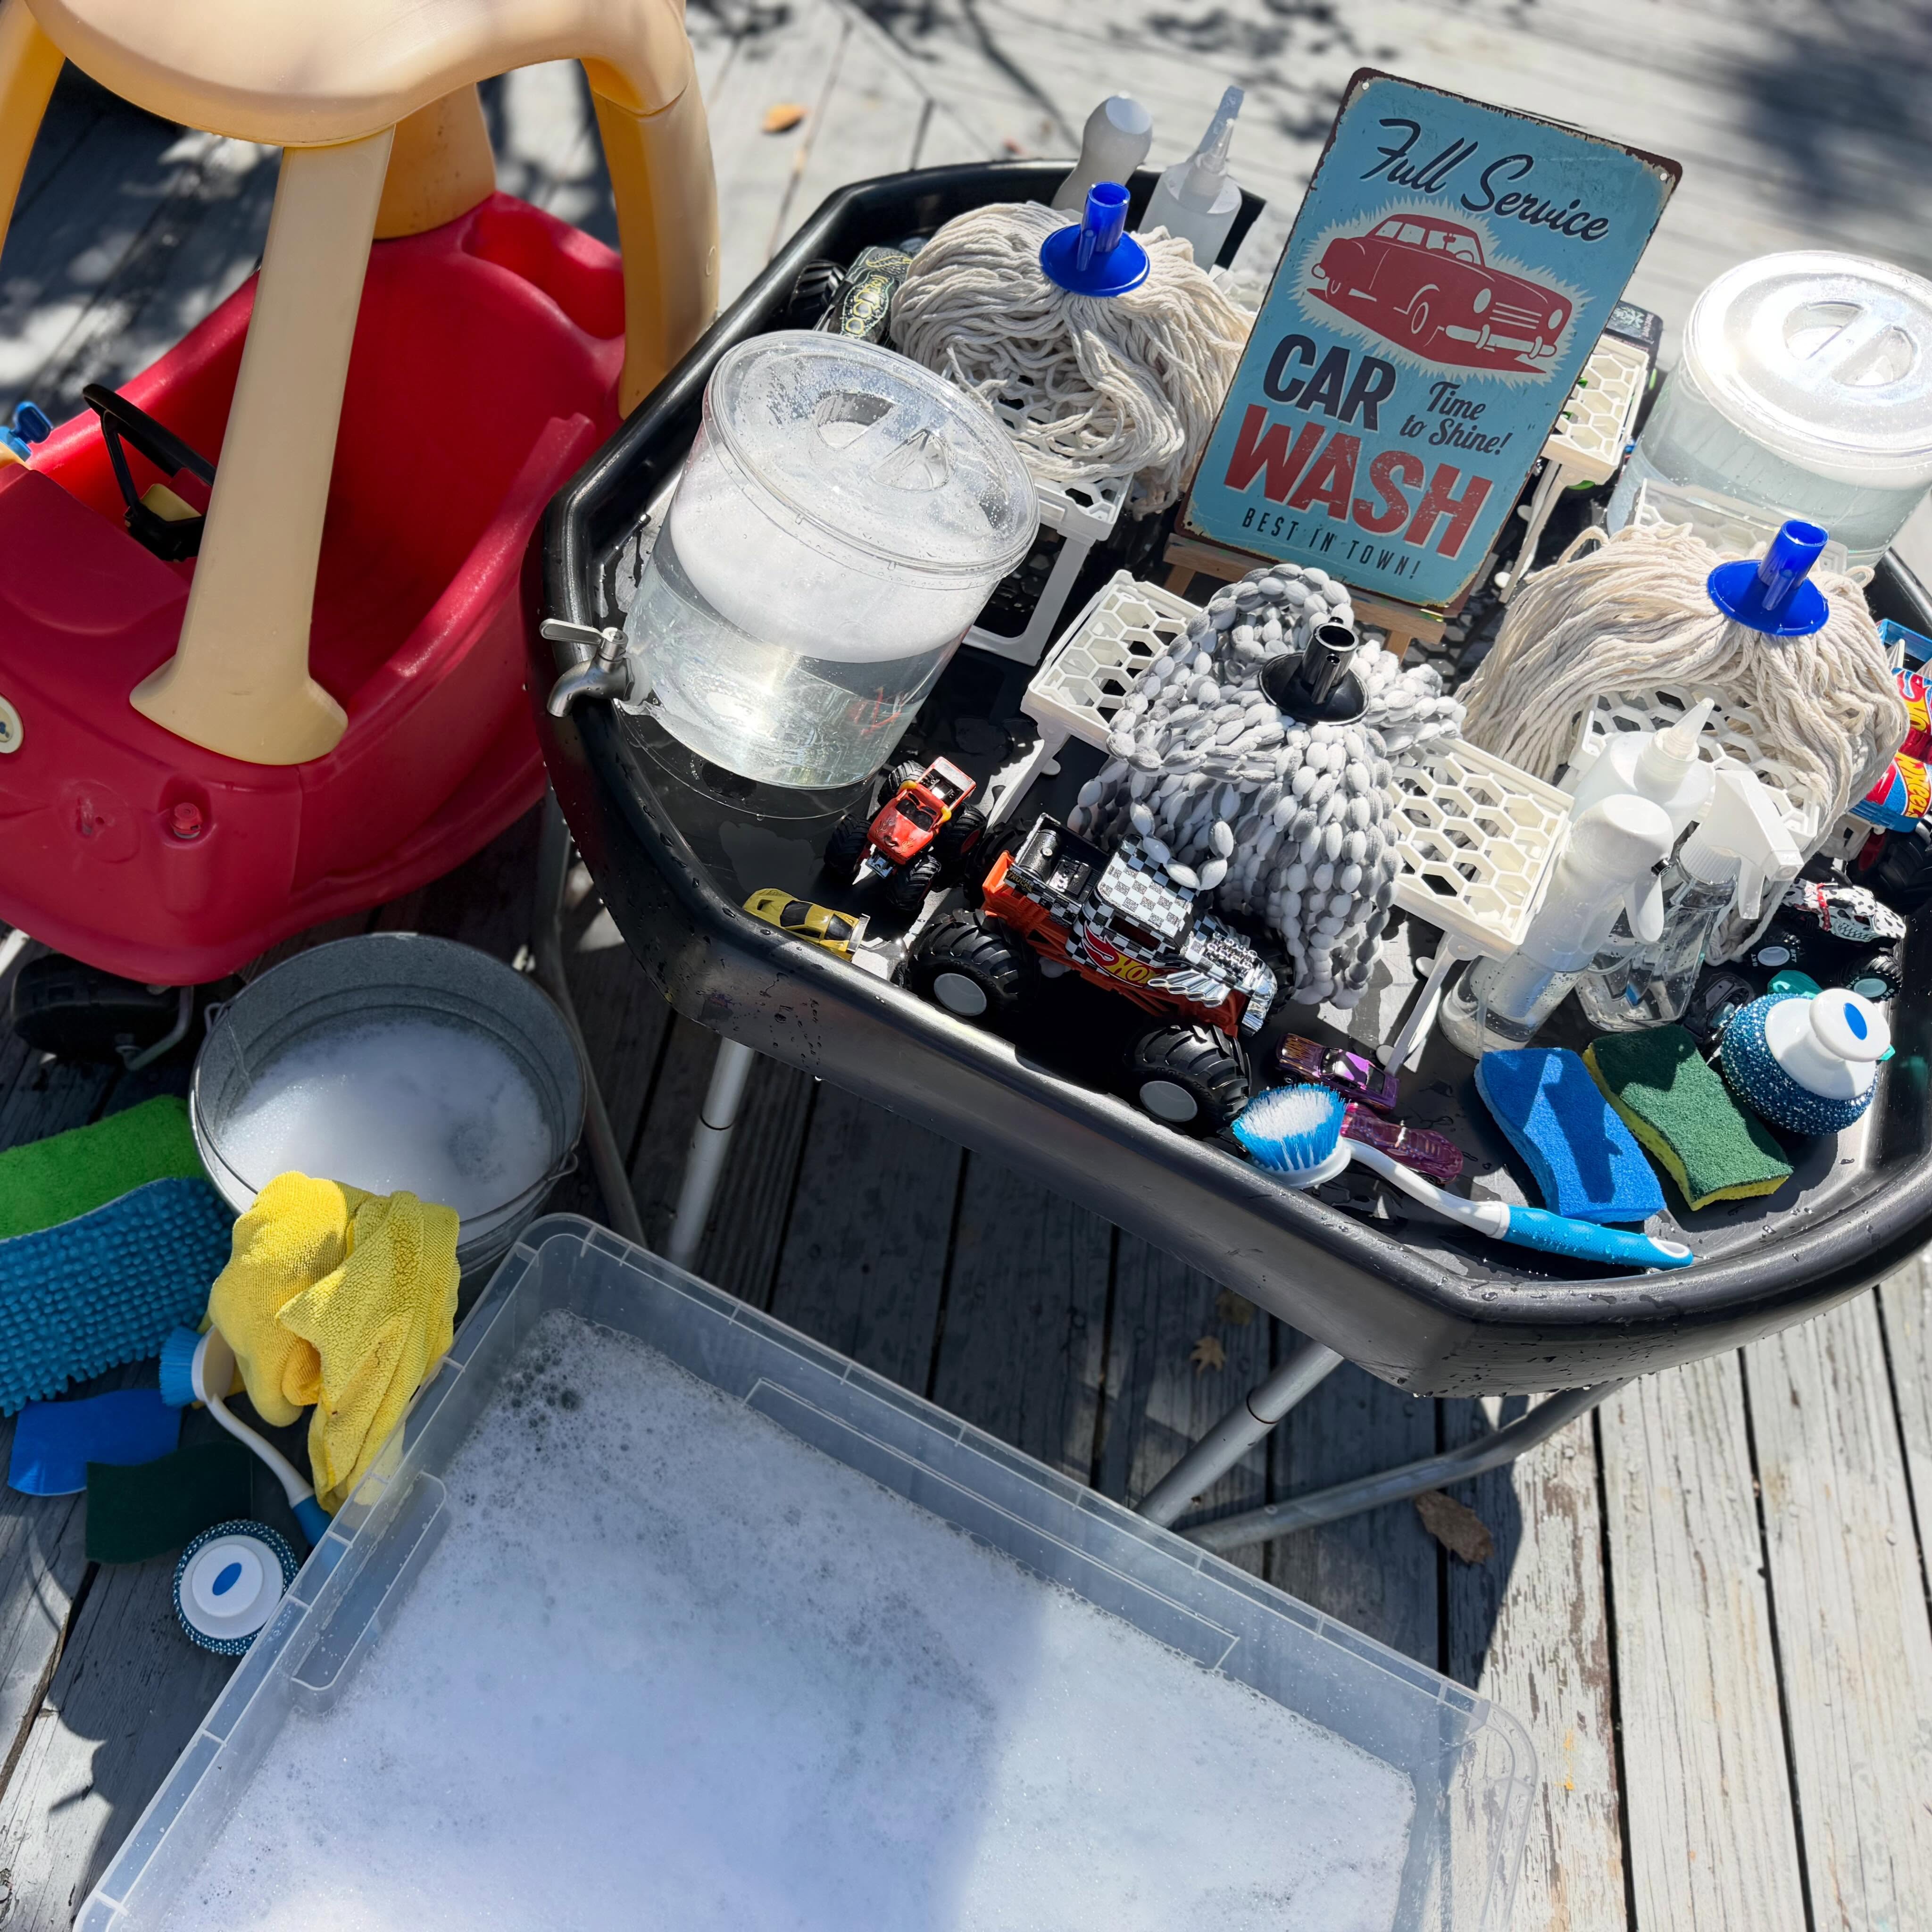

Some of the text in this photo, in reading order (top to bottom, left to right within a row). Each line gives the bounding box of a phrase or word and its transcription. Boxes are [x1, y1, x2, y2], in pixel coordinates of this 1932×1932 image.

[1359, 118, 1609, 242] Full Service
[1263, 333, 1397, 431] CAR
[1427, 381, 1487, 420] Time
[1399, 414, 1513, 455] to Shine!
[1224, 403, 1493, 558] WASH
[1242, 508, 1421, 580] BEST IN TOWN!
[1007, 872, 1033, 893] TRUCKS
